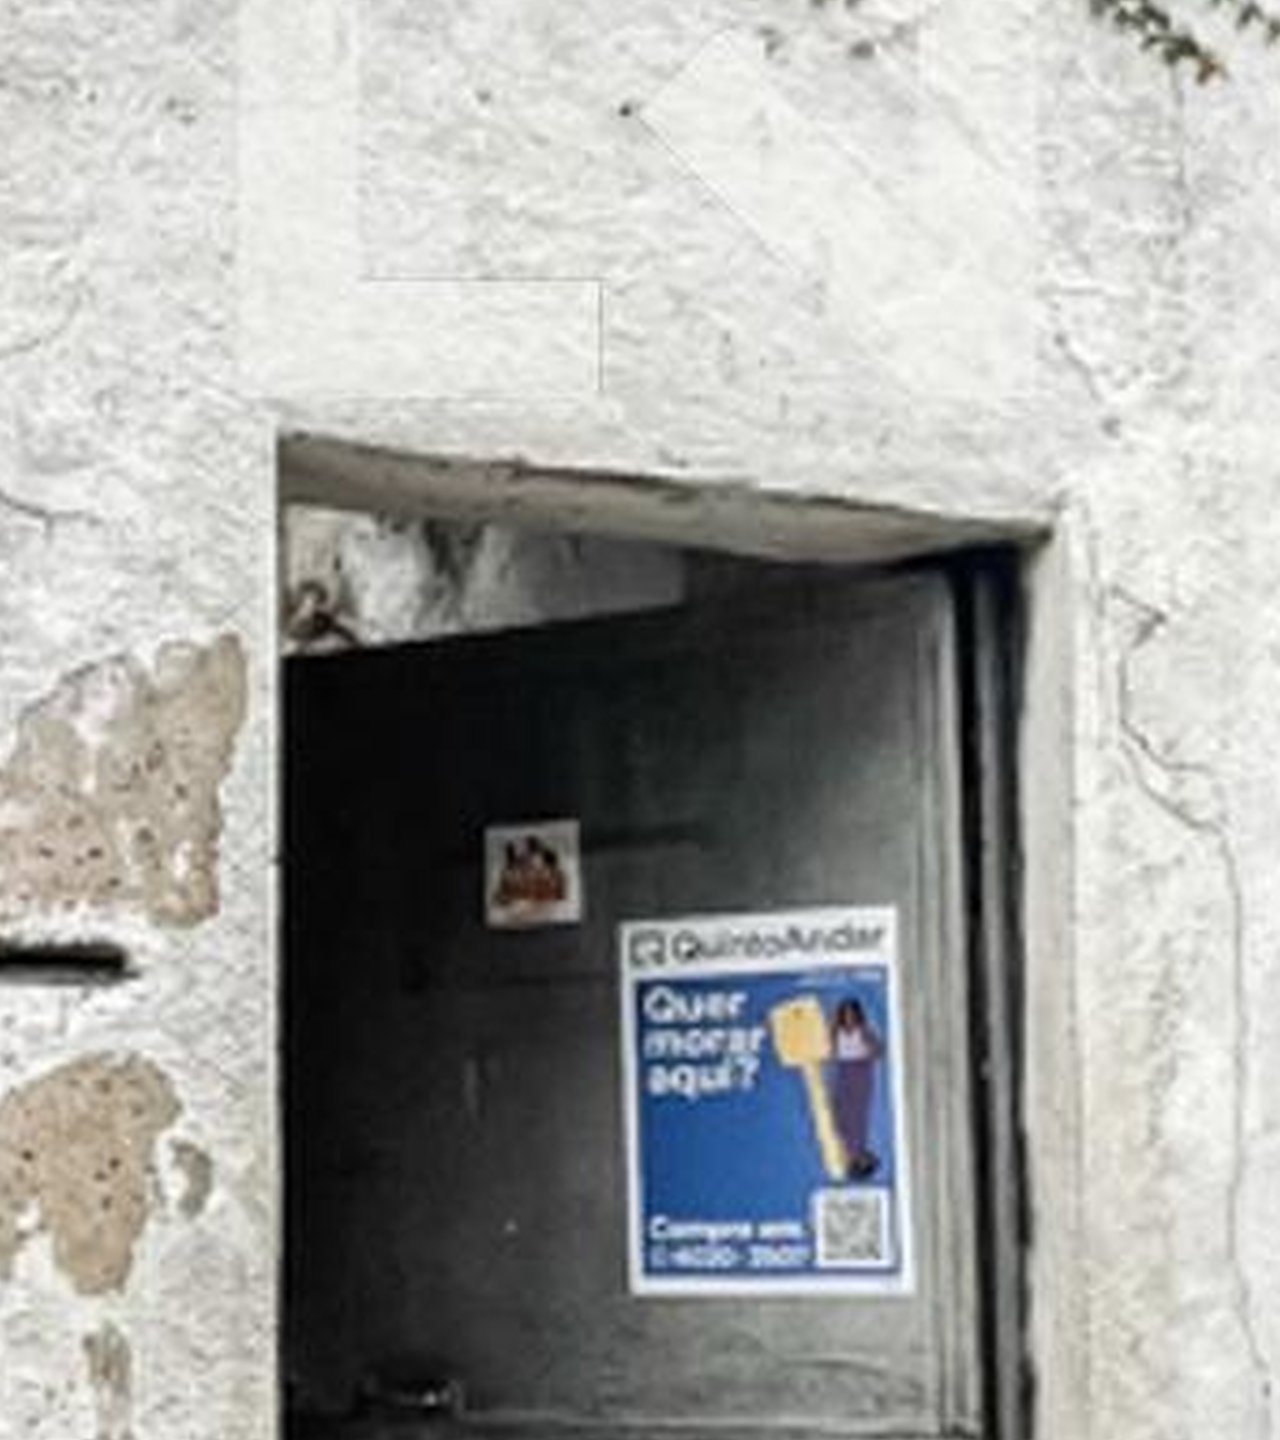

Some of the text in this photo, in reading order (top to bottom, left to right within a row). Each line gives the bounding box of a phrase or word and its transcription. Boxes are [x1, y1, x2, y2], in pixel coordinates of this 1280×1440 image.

[644, 987, 746, 1021] Quer
[643, 1026, 766, 1059] morar
[645, 1054, 760, 1100] aqui?
